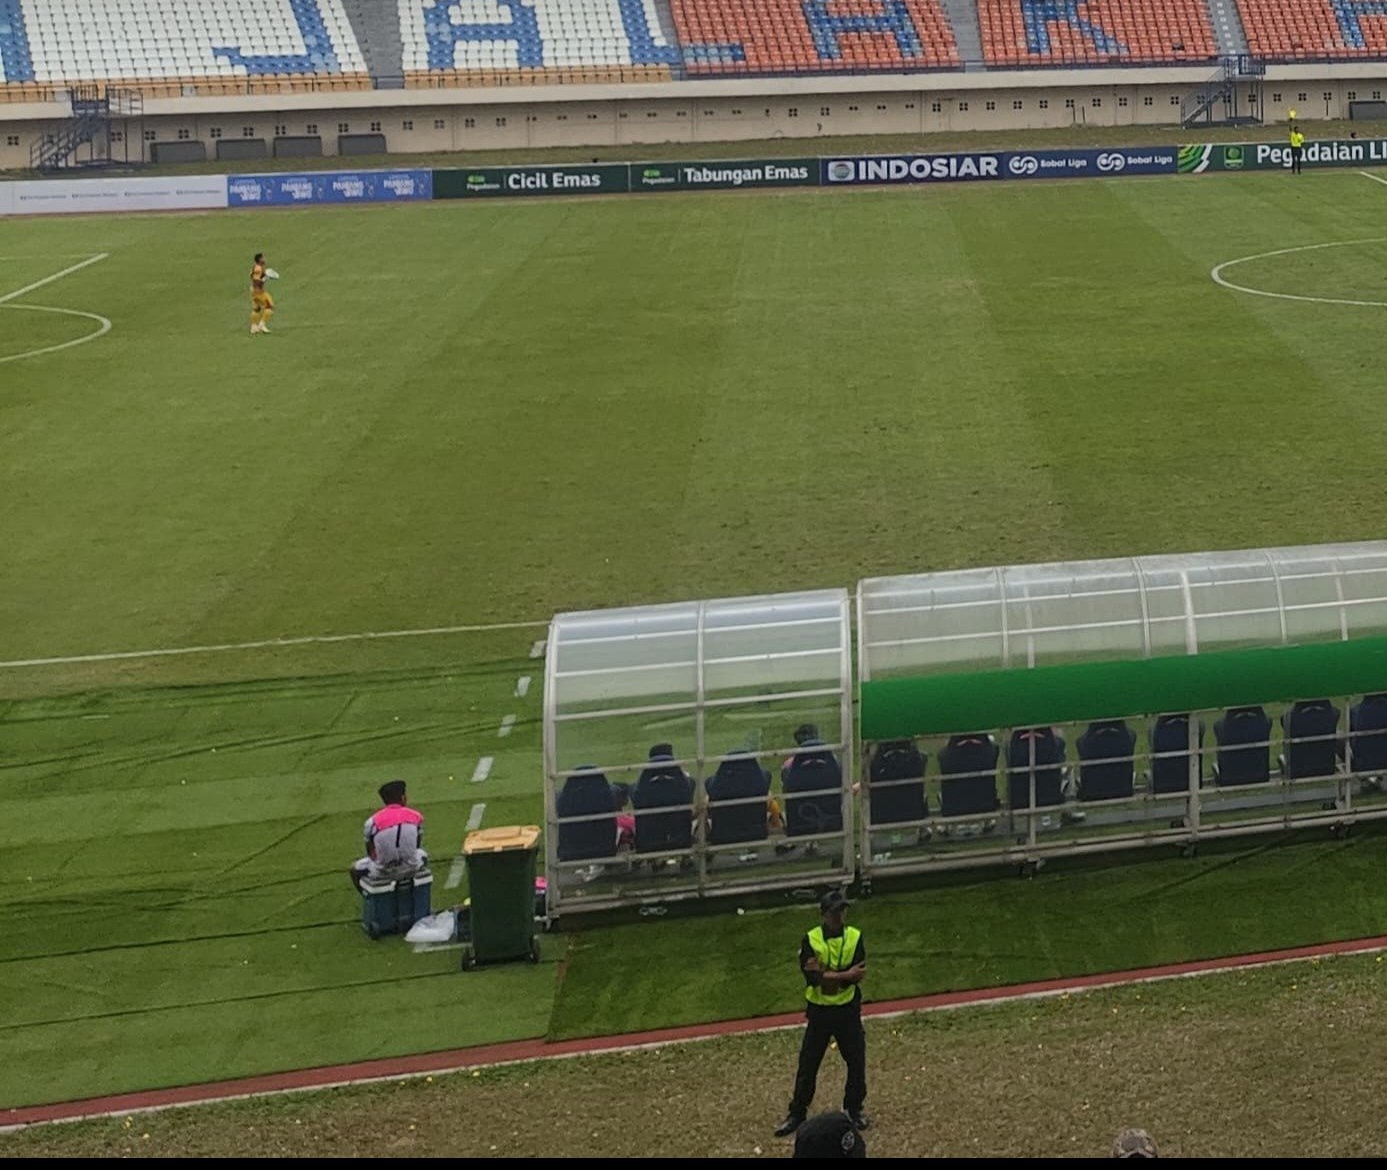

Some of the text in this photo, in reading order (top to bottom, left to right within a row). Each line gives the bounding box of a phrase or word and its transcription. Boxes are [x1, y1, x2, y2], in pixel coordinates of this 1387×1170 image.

[858, 156, 998, 180] INDOSIAR
[1068, 157, 1087, 170] Liga
[1154, 154, 1173, 167] Liga
[508, 171, 601, 190] Cicil Emas
[683, 165, 808, 187] Tabungan Emas
